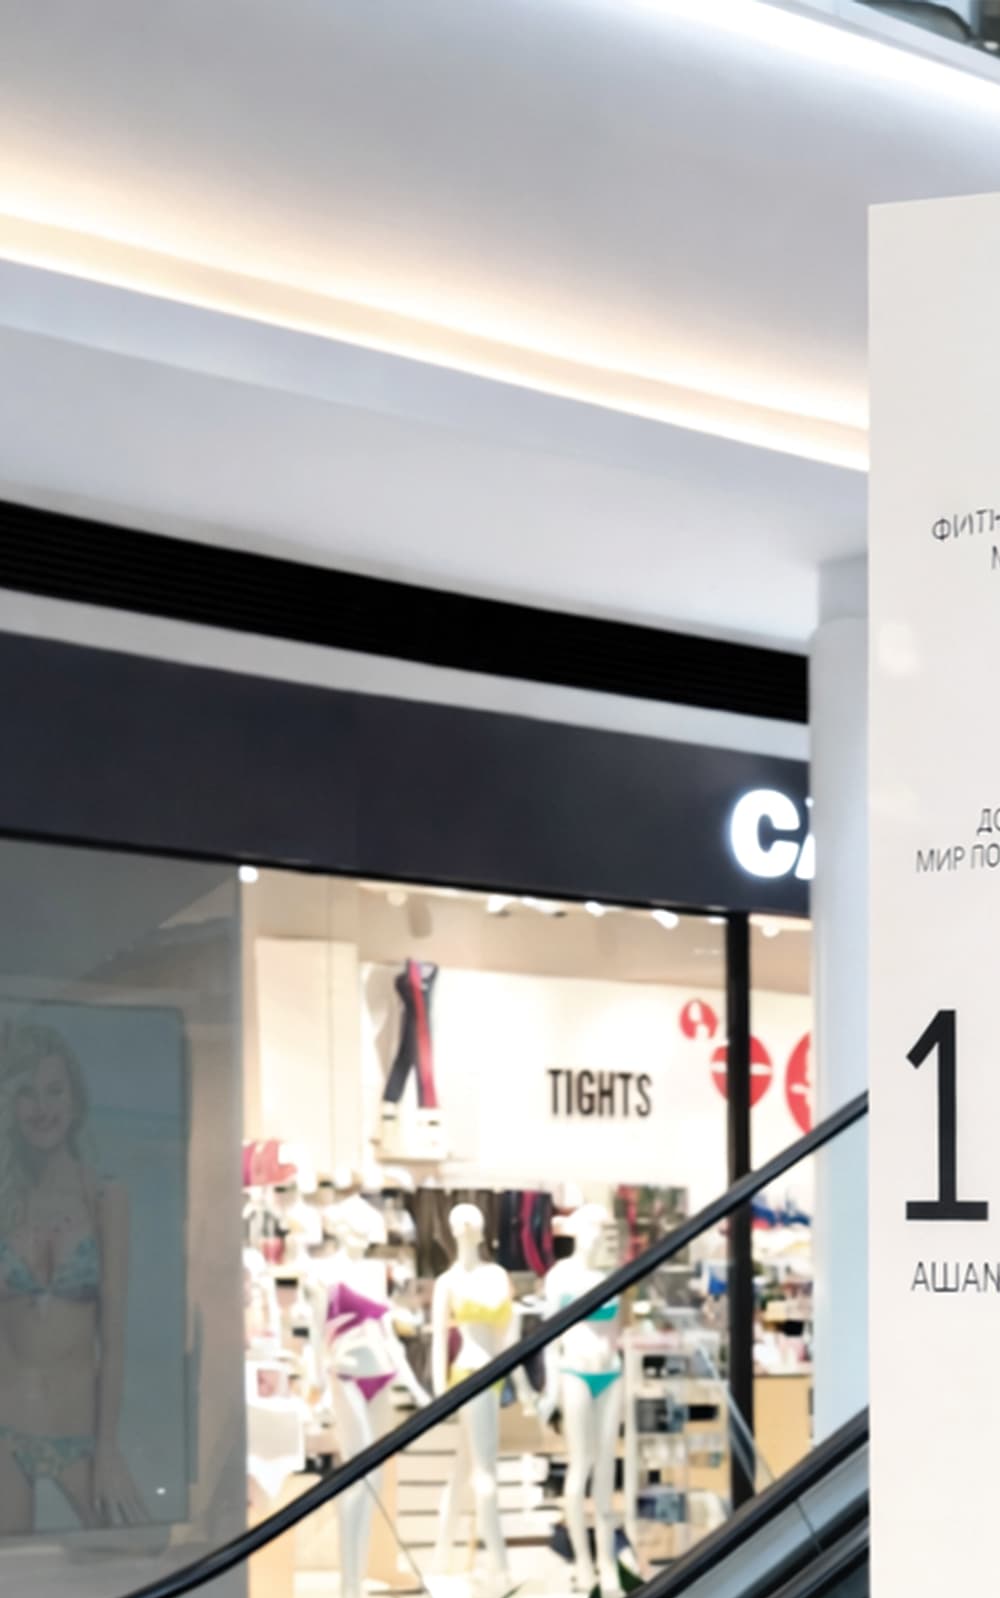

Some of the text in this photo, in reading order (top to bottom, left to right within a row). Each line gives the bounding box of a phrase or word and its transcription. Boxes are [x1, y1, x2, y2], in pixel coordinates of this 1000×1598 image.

[915, 848, 965, 873] МИР
[970, 843, 1000, 869] ПО
[547, 1068, 653, 1118] TIGHTS
[906, 1009, 989, 1221] 1
